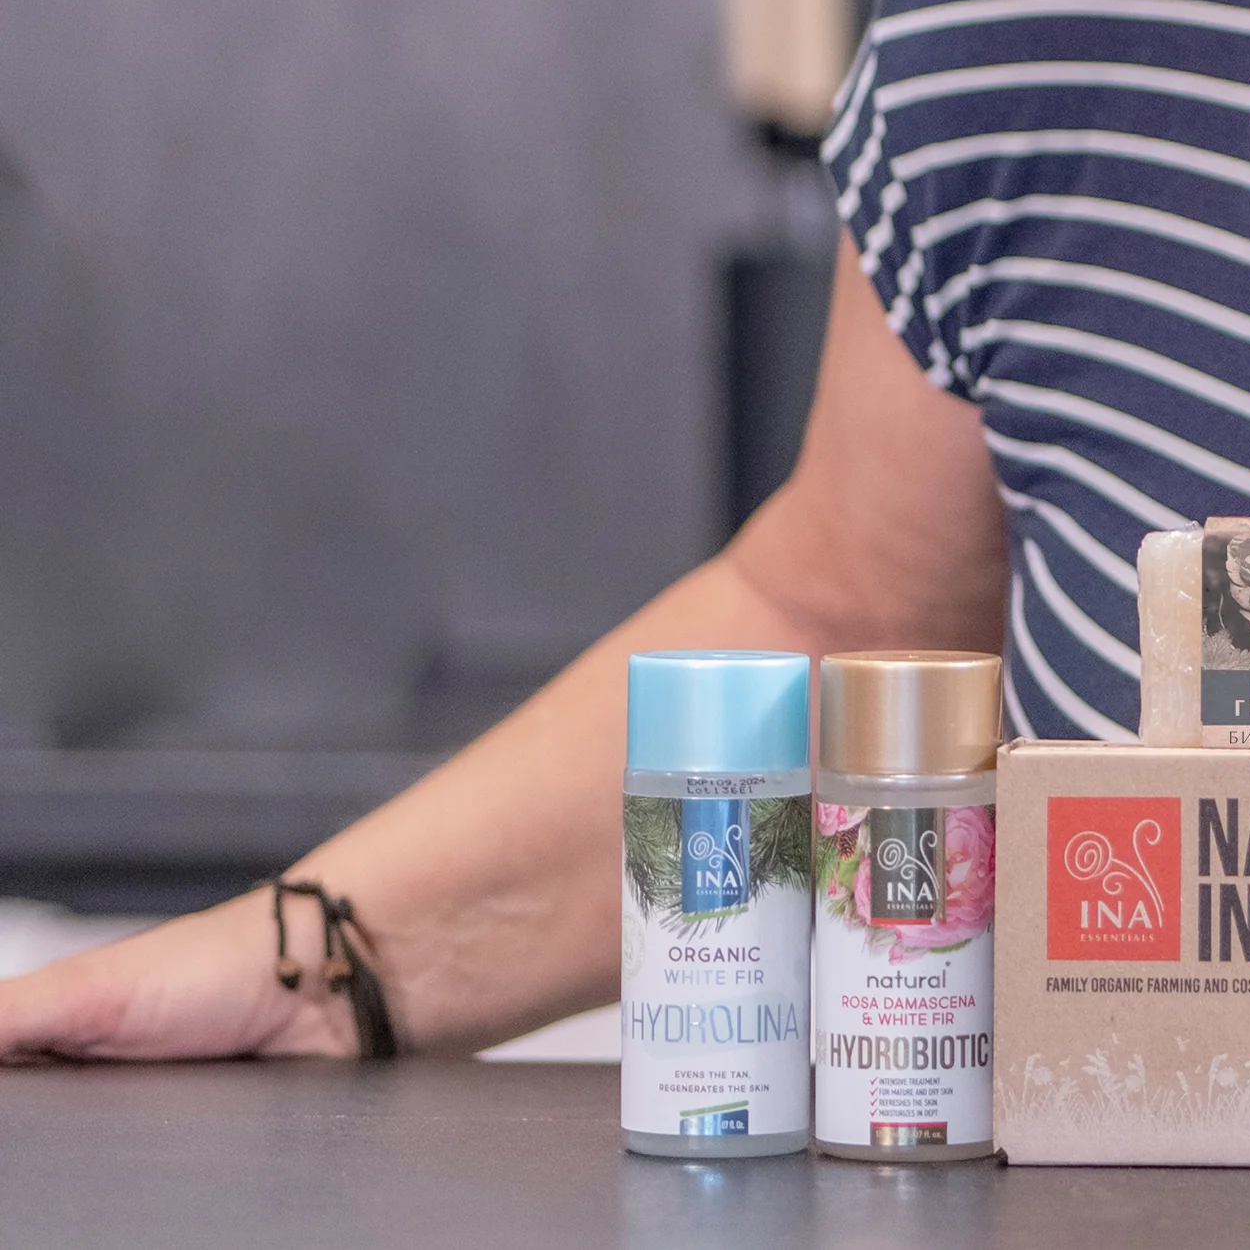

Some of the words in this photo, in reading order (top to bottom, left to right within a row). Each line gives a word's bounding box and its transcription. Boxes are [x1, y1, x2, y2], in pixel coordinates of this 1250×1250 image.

[696, 870, 739, 888] INA
[887, 882, 934, 902] INA
[1081, 900, 1153, 929] INA
[1080, 933, 1155, 942] ESSENTIALS
[668, 946, 761, 963] ORGANIC
[664, 969, 727, 985] WHITE
[735, 969, 765, 985] FIR
[1046, 977, 1088, 993] FAMILY
[1091, 977, 1143, 993] ORGANIC
[1147, 977, 1200, 993] FARMING
[1203, 978, 1228, 993] AND
[841, 995, 879, 1010] ROSA
[883, 995, 976, 1010] DAMASCENA
[631, 1001, 800, 1044] HYDROLINA
[862, 1012, 873, 1026] &
[878, 1013, 928, 1026] WHITE
[932, 1012, 955, 1026] FIR
[830, 1031, 989, 1070] HYDROBIOTIC
[674, 1070, 705, 1079] EVENS
[708, 1071, 728, 1079] THE
[909, 1077, 940, 1086] TREATMENT
[659, 1083, 725, 1093] REGENERATES
[728, 1084, 746, 1093] THE
[749, 1084, 770, 1093] SKIN
[915, 1088, 928, 1096] AND
[924, 1098, 938, 1107] SKIN
